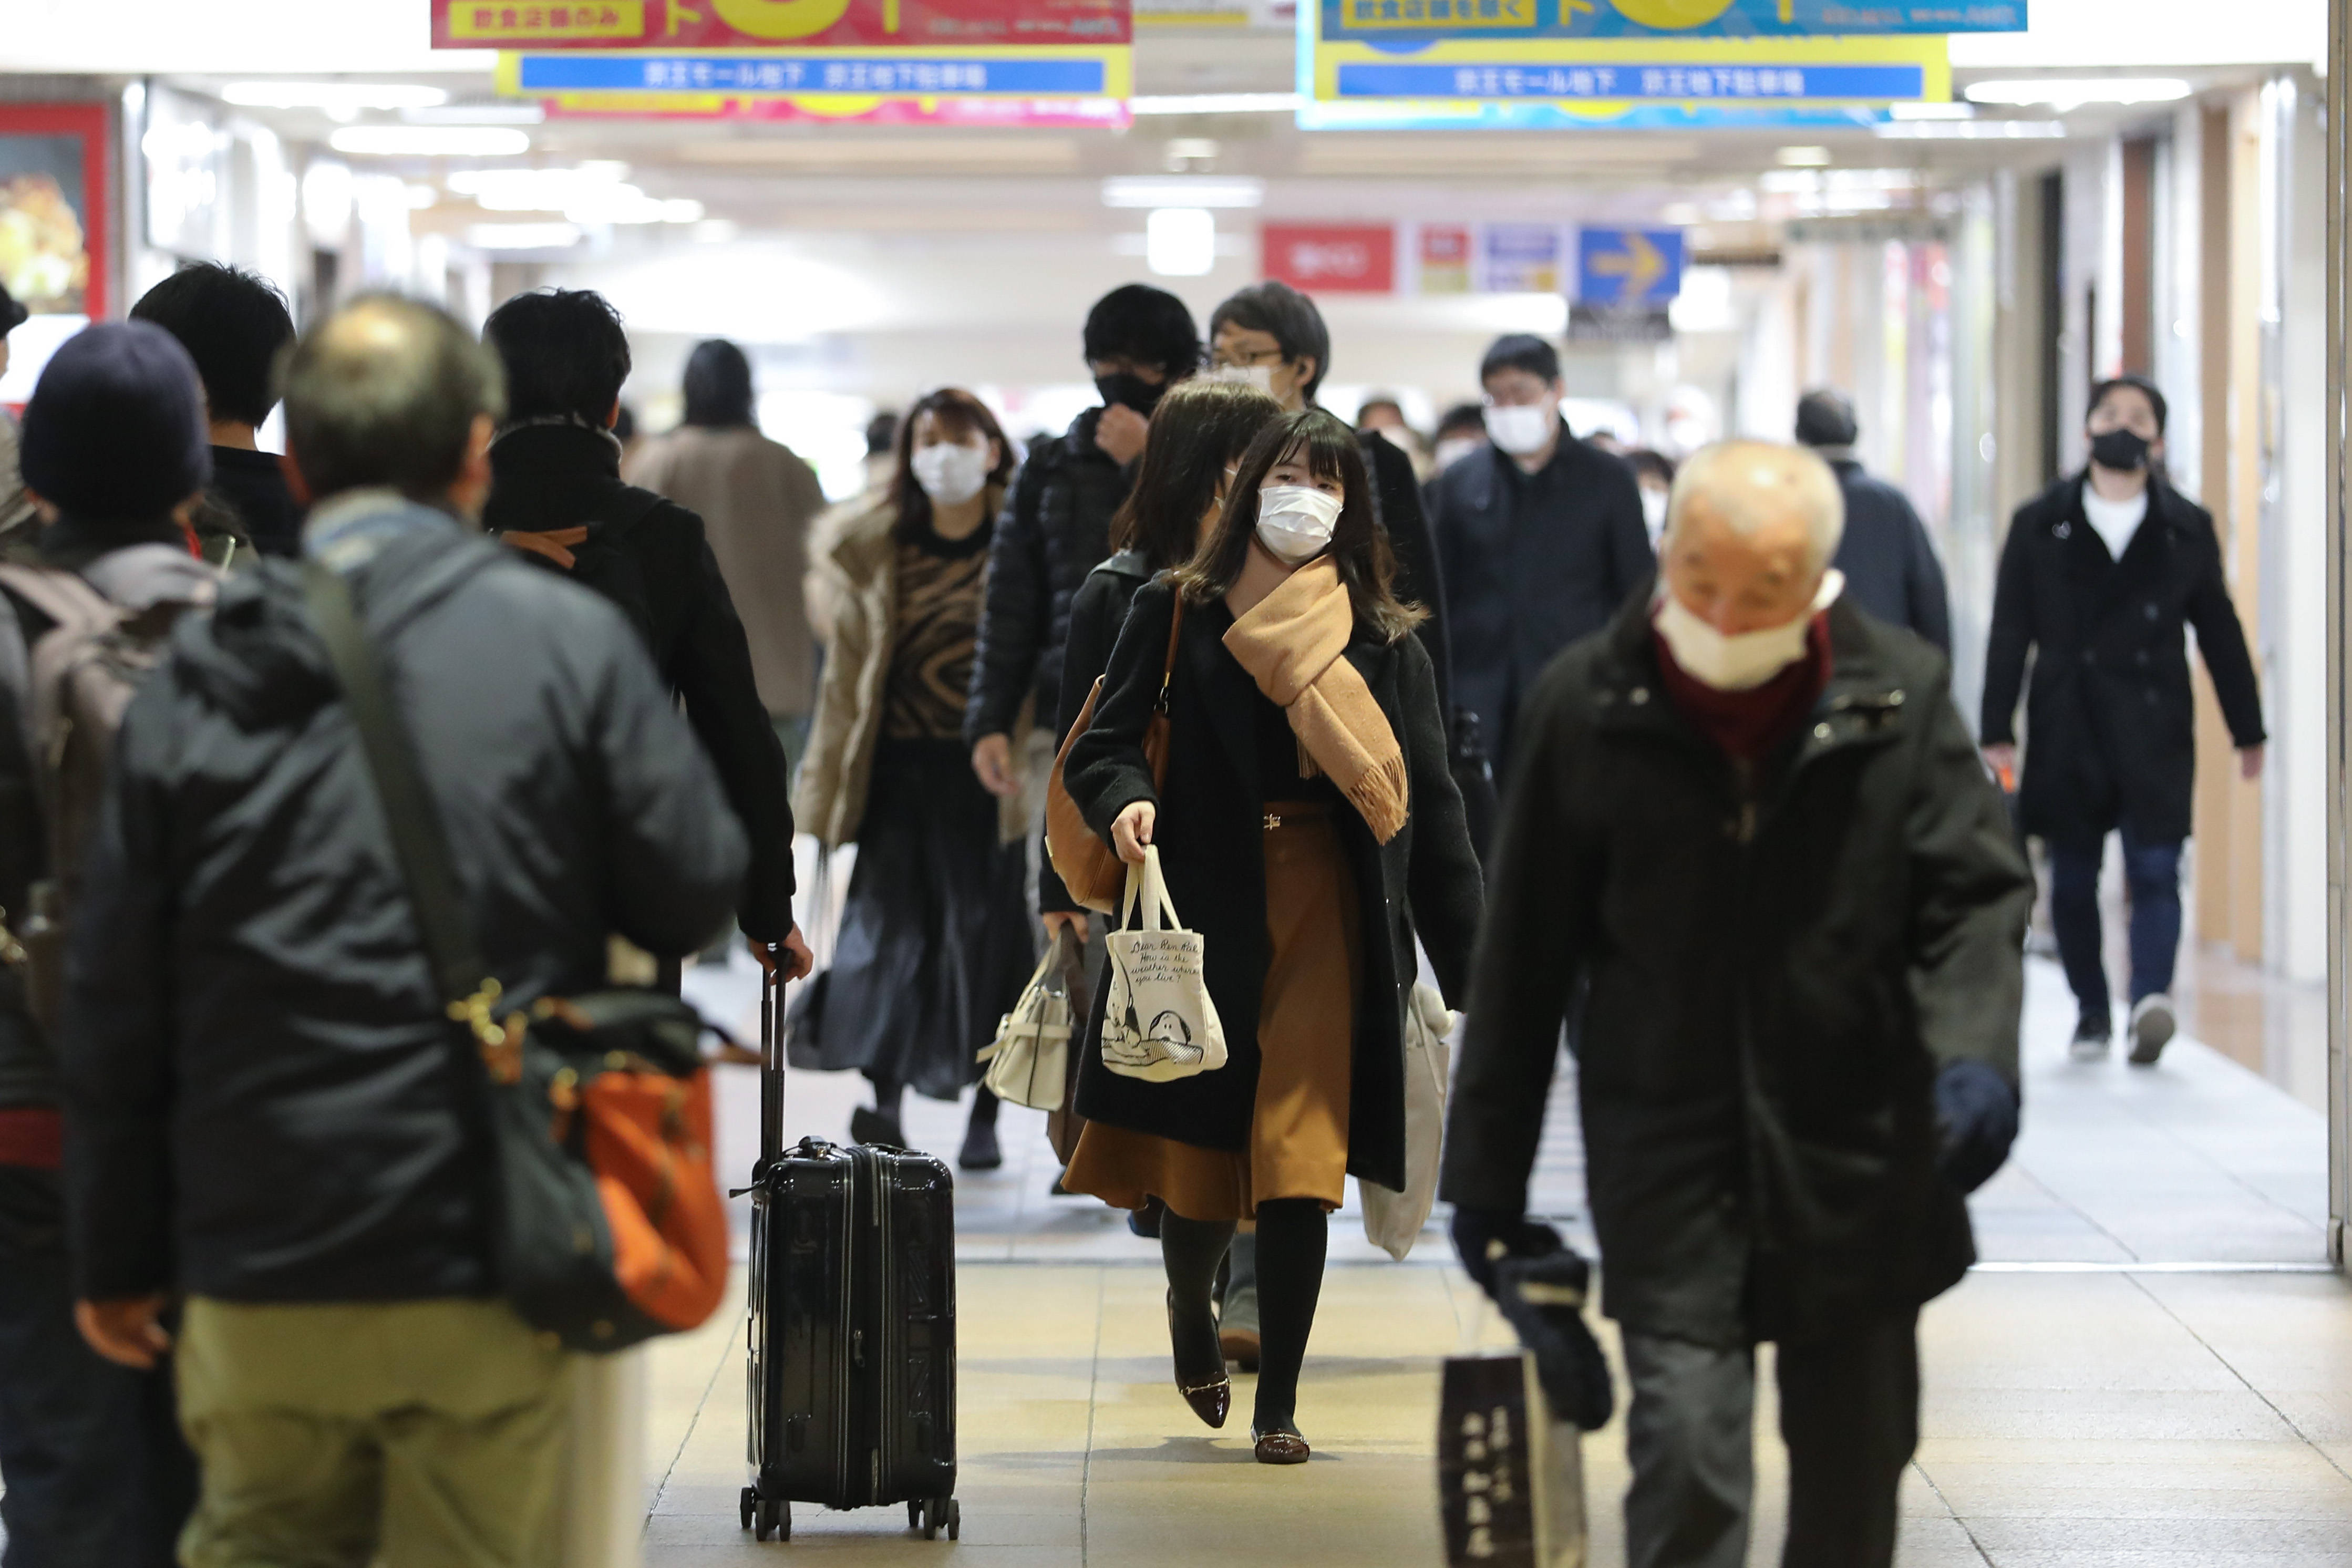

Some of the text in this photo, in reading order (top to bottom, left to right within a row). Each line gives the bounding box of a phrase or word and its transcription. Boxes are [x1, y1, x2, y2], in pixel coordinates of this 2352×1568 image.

[1130, 941, 1157, 954] Dear
[1160, 938, 1177, 950] Pen
[1140, 952, 1190, 964] How is the
[1131, 962, 1199, 975] weather where
[1135, 975, 1151, 987] you
